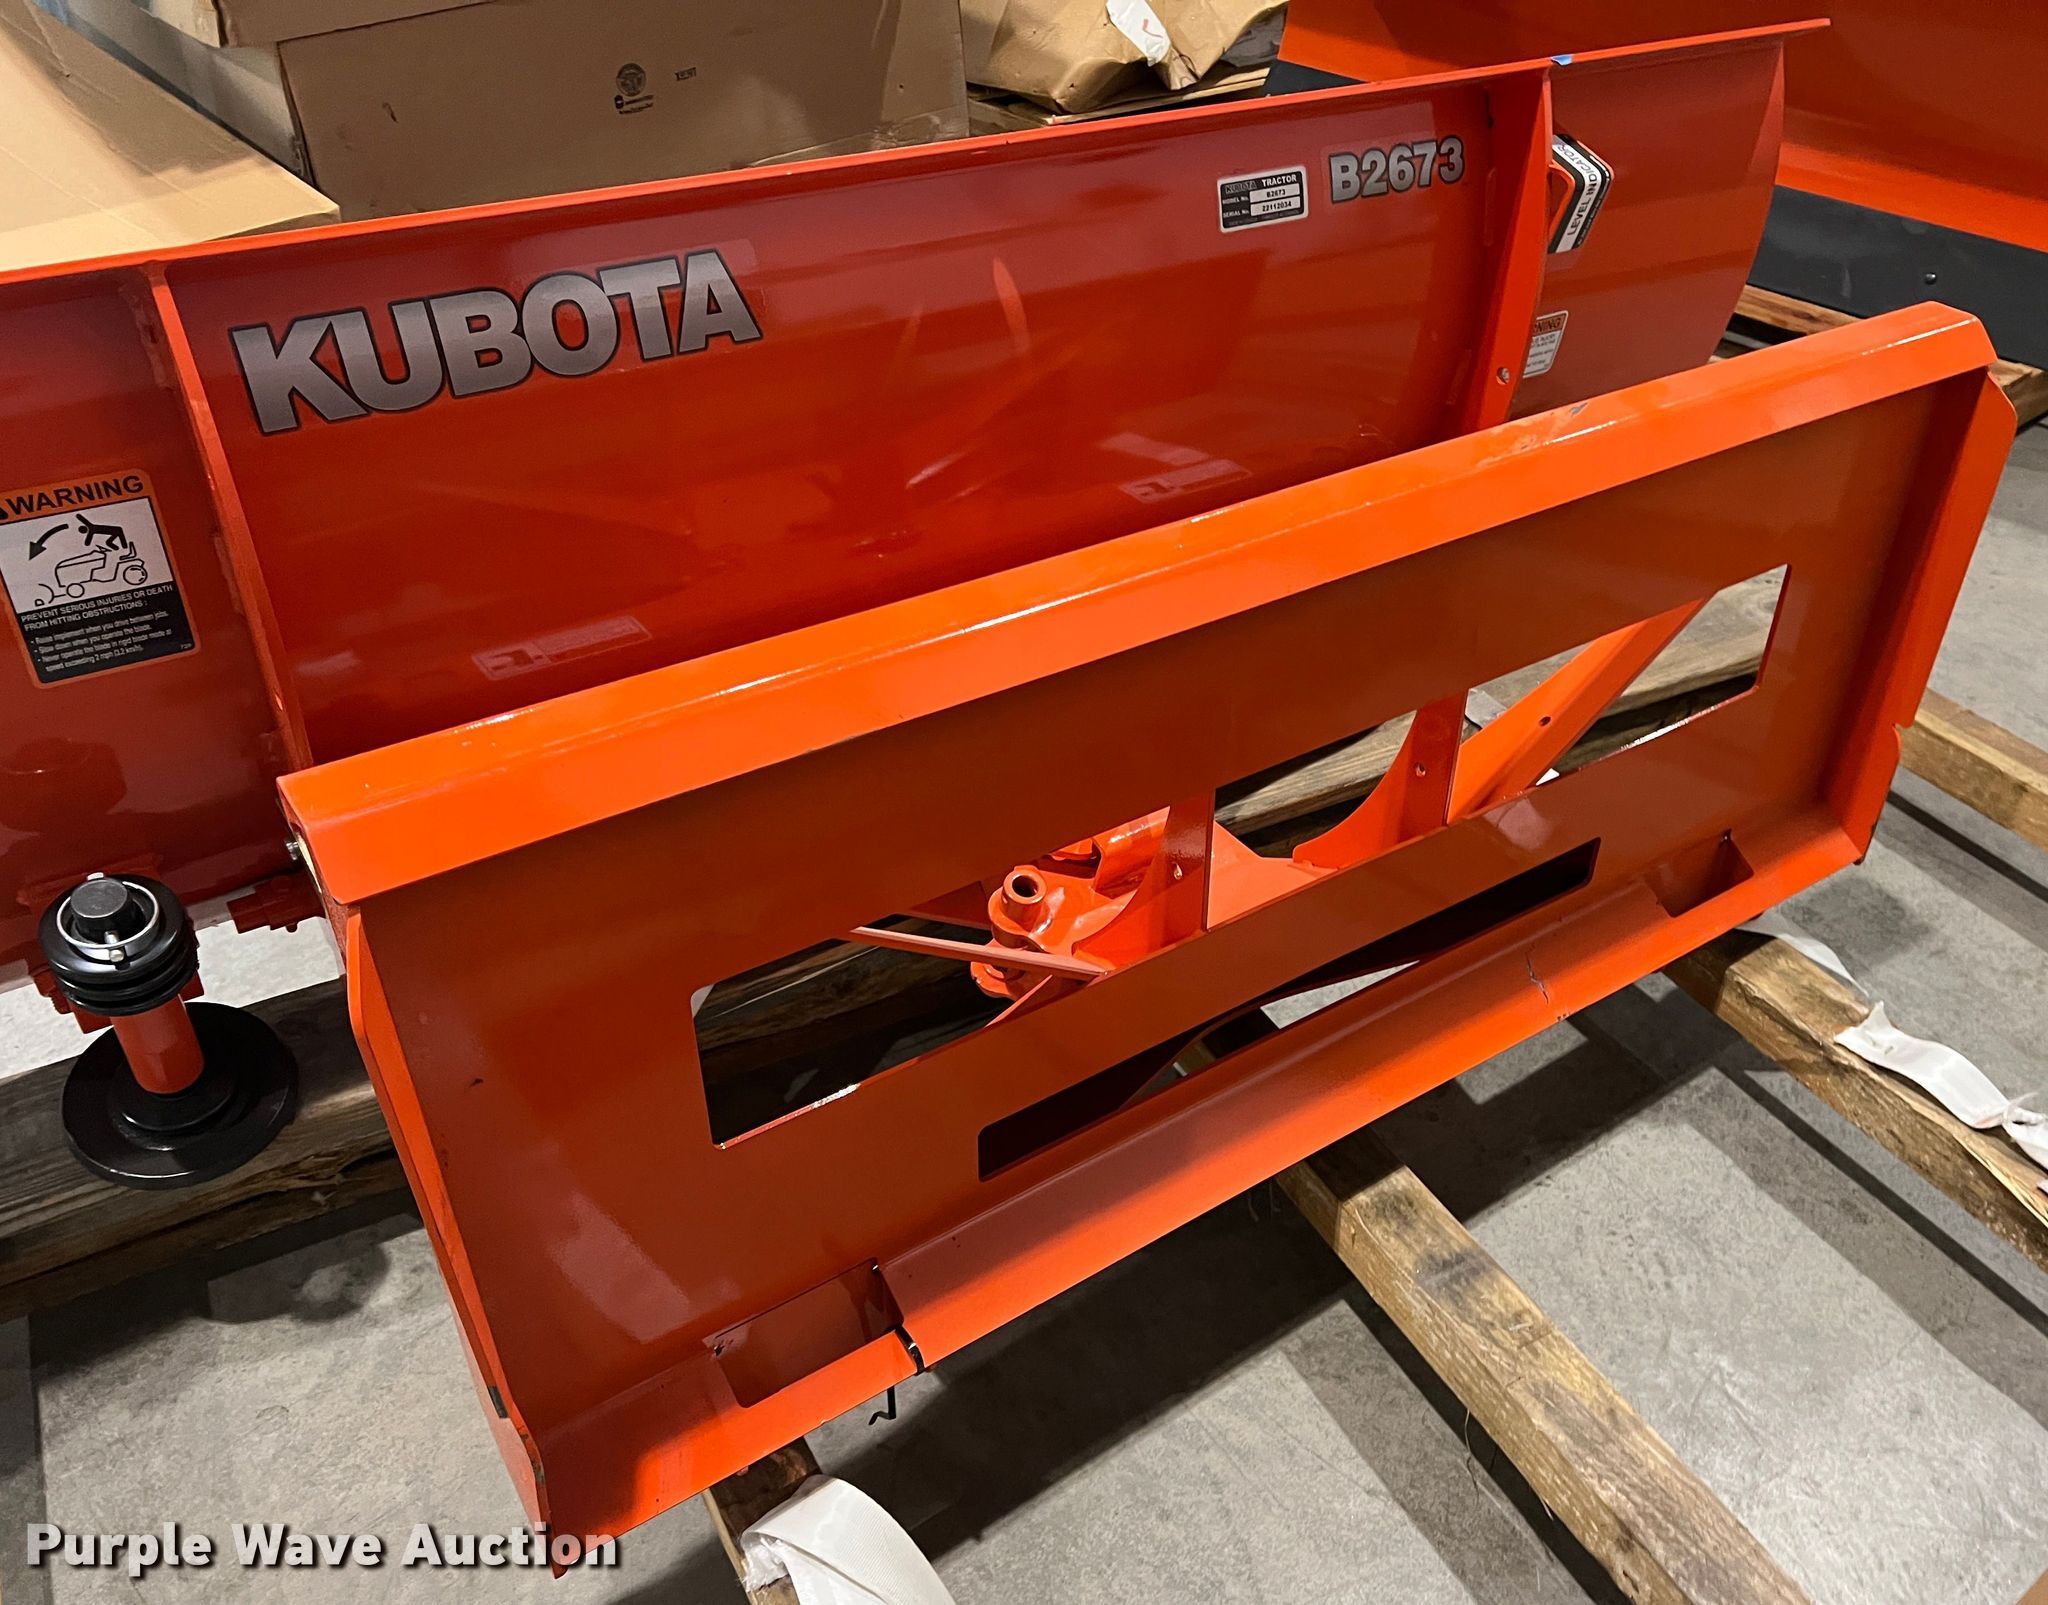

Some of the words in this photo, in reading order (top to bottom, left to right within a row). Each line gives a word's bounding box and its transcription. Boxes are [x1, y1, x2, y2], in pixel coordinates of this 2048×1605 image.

[1261, 174, 1297, 187] TRACTOR
[1328, 134, 1465, 204] B2673
[1557, 144, 1598, 196] INDICATOR
[1262, 201, 1292, 212] 22112034
[1567, 197, 1592, 236] LEVEL
[229, 249, 763, 436] KUBOTA
[6, 475, 144, 516] WARNING
[21, 609, 58, 623] PREVENT
[60, 601, 96, 615] SERIOUS
[96, 592, 133, 606] INJURIES
[133, 590, 145, 599] OR
[146, 585, 173, 596] DEATH
[24, 621, 49, 631] FROM
[49, 613, 81, 626] HITTING
[82, 600, 143, 619] OBSTRUCTIONS
